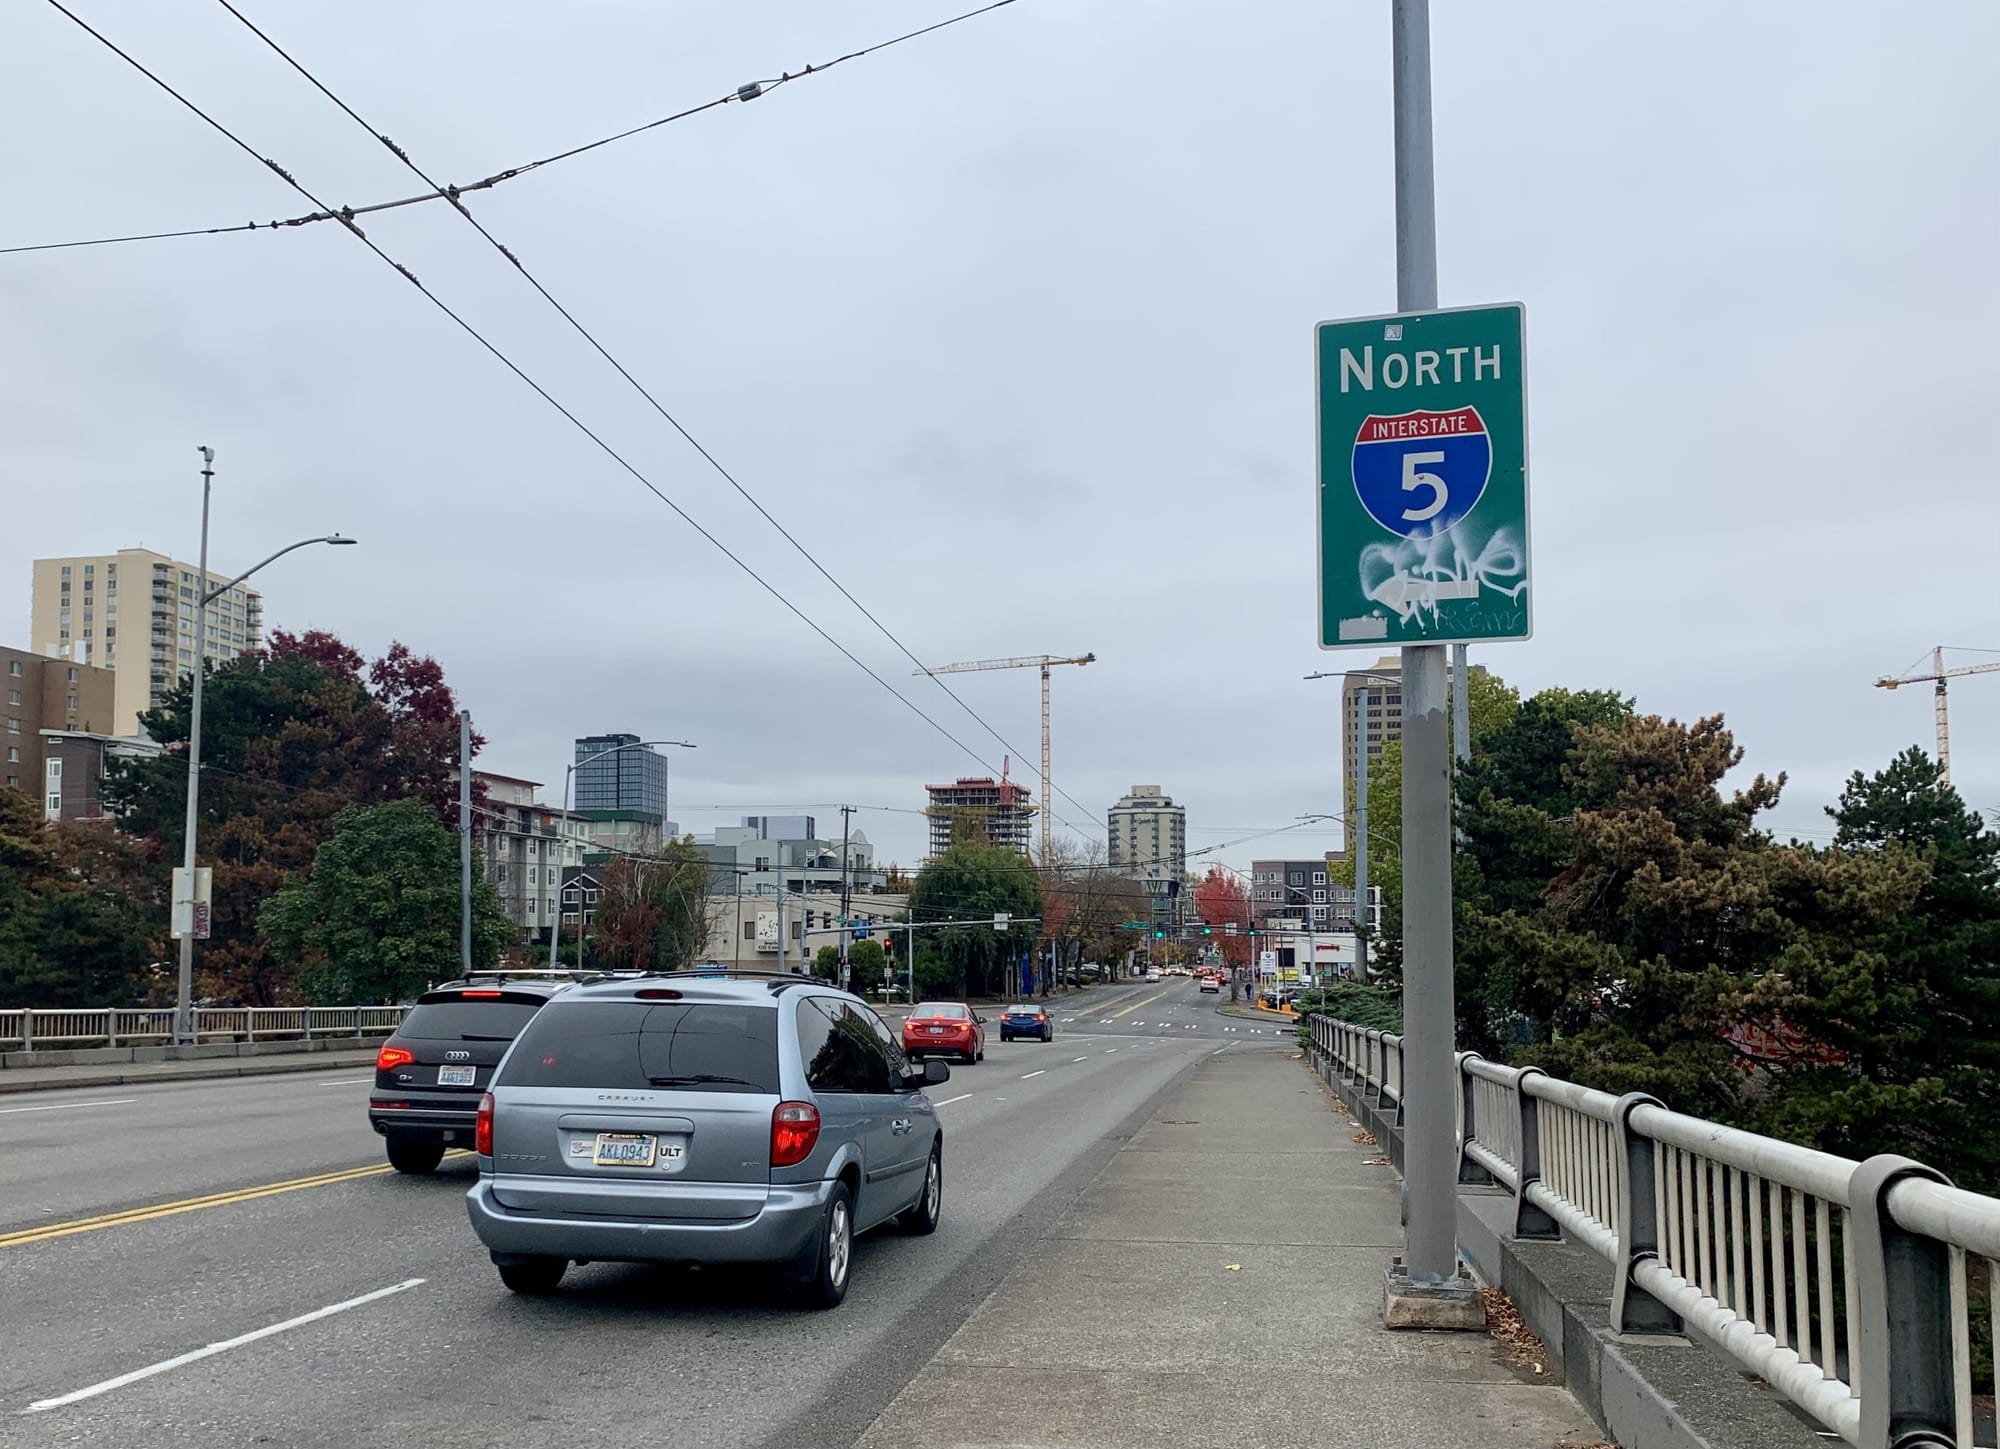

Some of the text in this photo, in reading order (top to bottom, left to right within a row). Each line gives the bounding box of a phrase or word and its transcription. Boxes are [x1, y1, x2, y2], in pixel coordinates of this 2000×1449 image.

[1340, 344, 1501, 393] NORTH
[1373, 415, 1467, 438] INTERSTATE
[1401, 450, 1449, 521] 5
[598, 1142, 651, 1161] AKL0943
[660, 1147, 682, 1158] ULT
